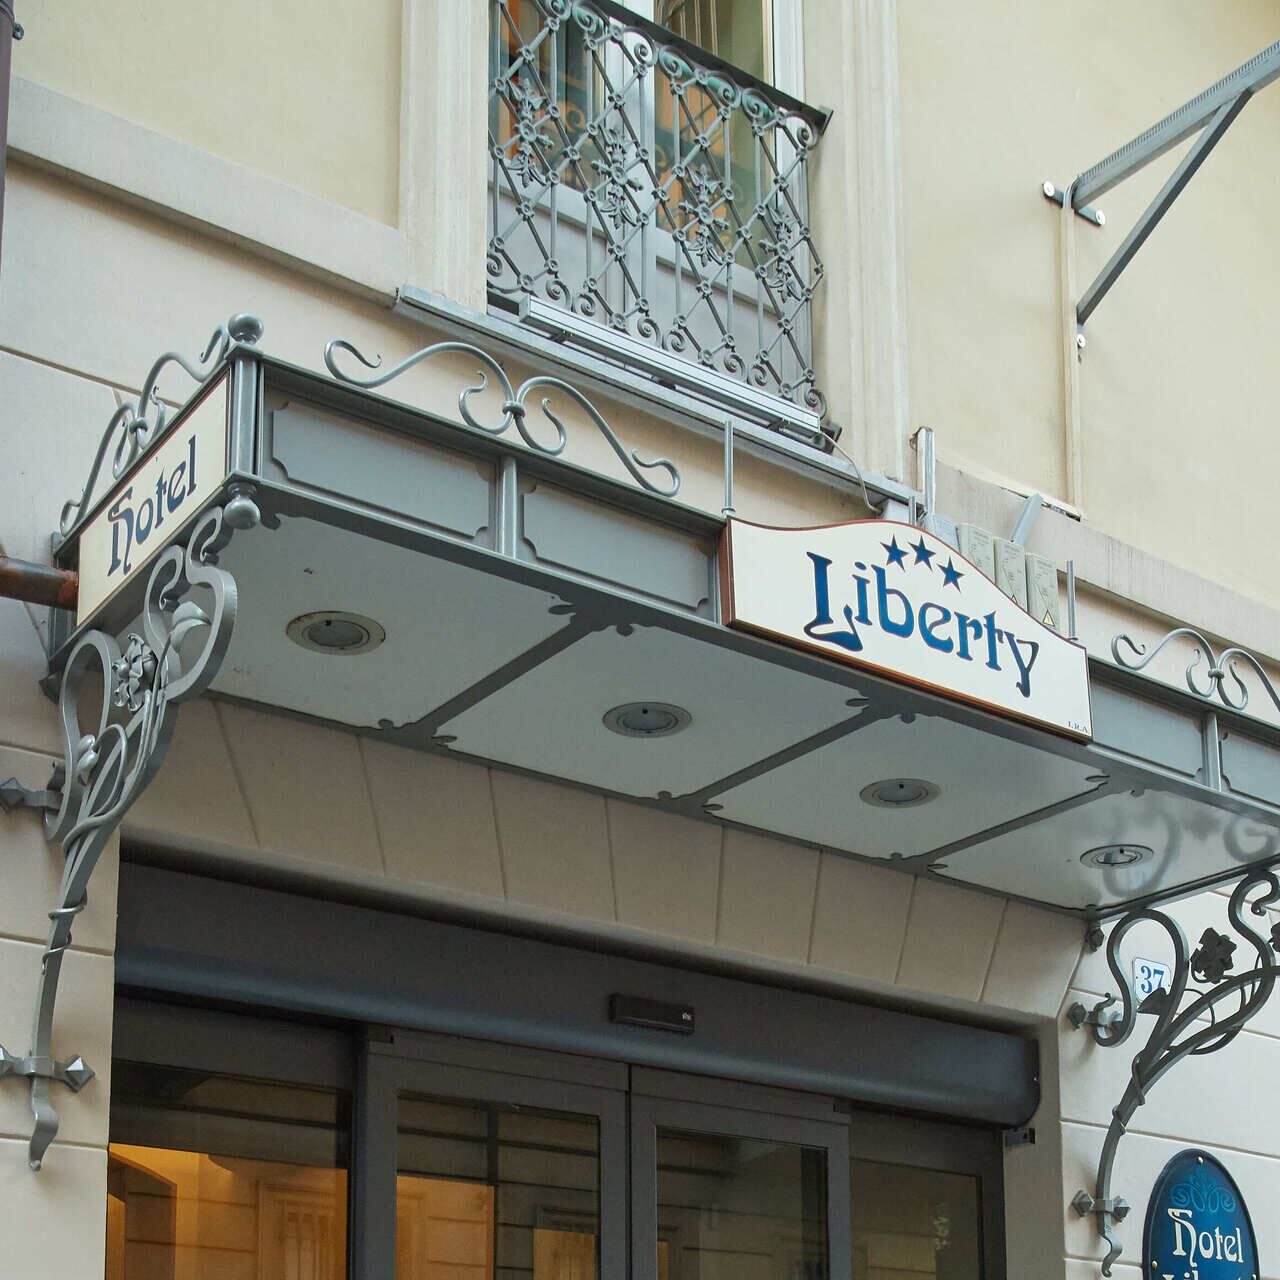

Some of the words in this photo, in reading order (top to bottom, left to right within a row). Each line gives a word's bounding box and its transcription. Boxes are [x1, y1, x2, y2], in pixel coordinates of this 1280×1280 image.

[107, 434, 198, 577] Hotel
[803, 551, 1040, 698] Liberty
[1141, 965, 1165, 994] 37
[1167, 1208, 1244, 1267] Hotel
